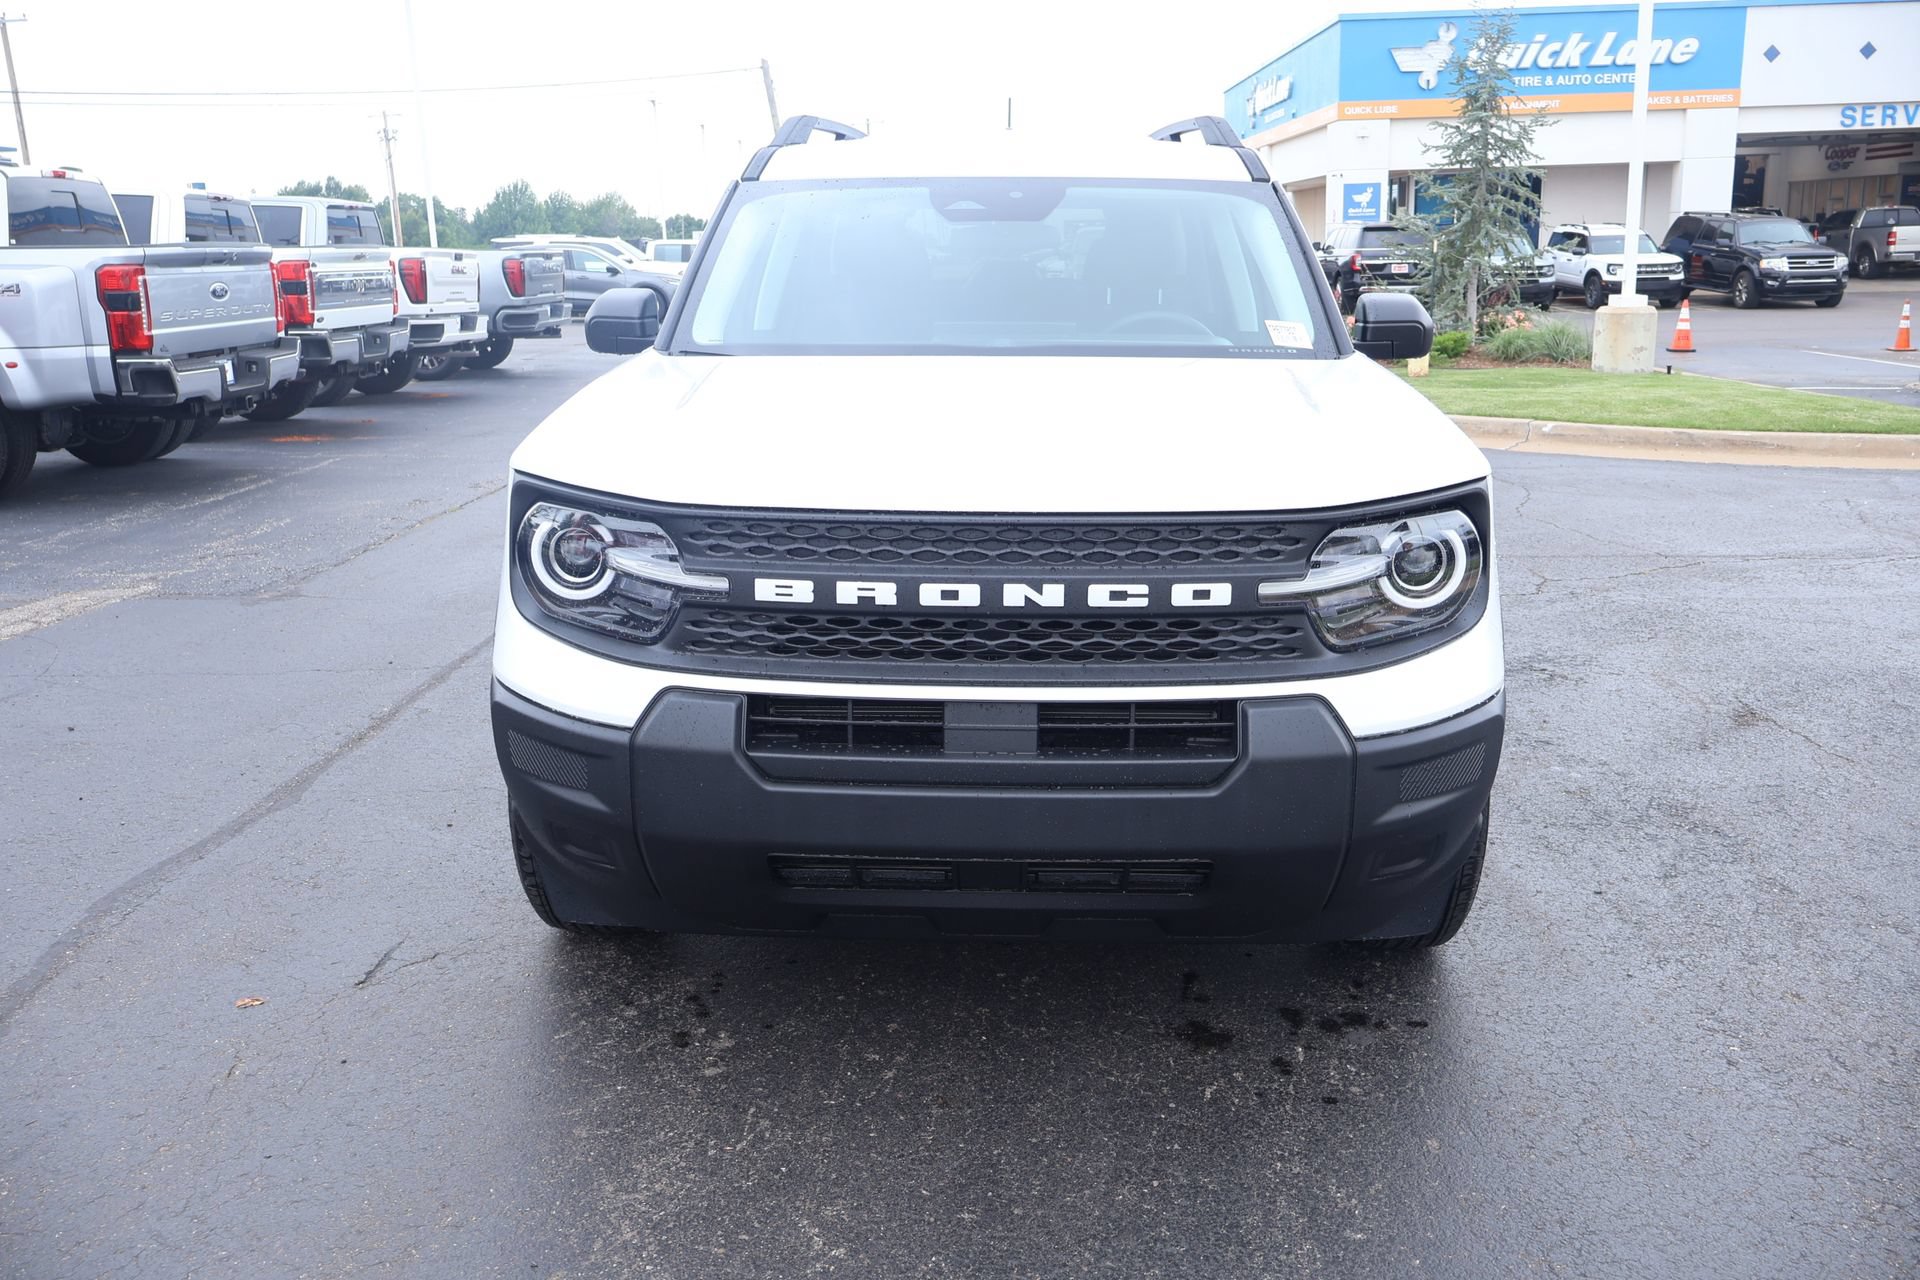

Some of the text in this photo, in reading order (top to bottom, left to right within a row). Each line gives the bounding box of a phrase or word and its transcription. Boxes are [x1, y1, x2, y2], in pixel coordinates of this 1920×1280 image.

[1513, 72, 1637, 88] TIRE & AUTO CENTE
[1646, 94, 1734, 105] AKES & BATTERIES
[1344, 105, 1399, 115] QUICK LUBE
[1839, 103, 1920, 128] SERV
[160, 303, 271, 321] SUPER DUTY
[754, 578, 1232, 607] BRONCO
